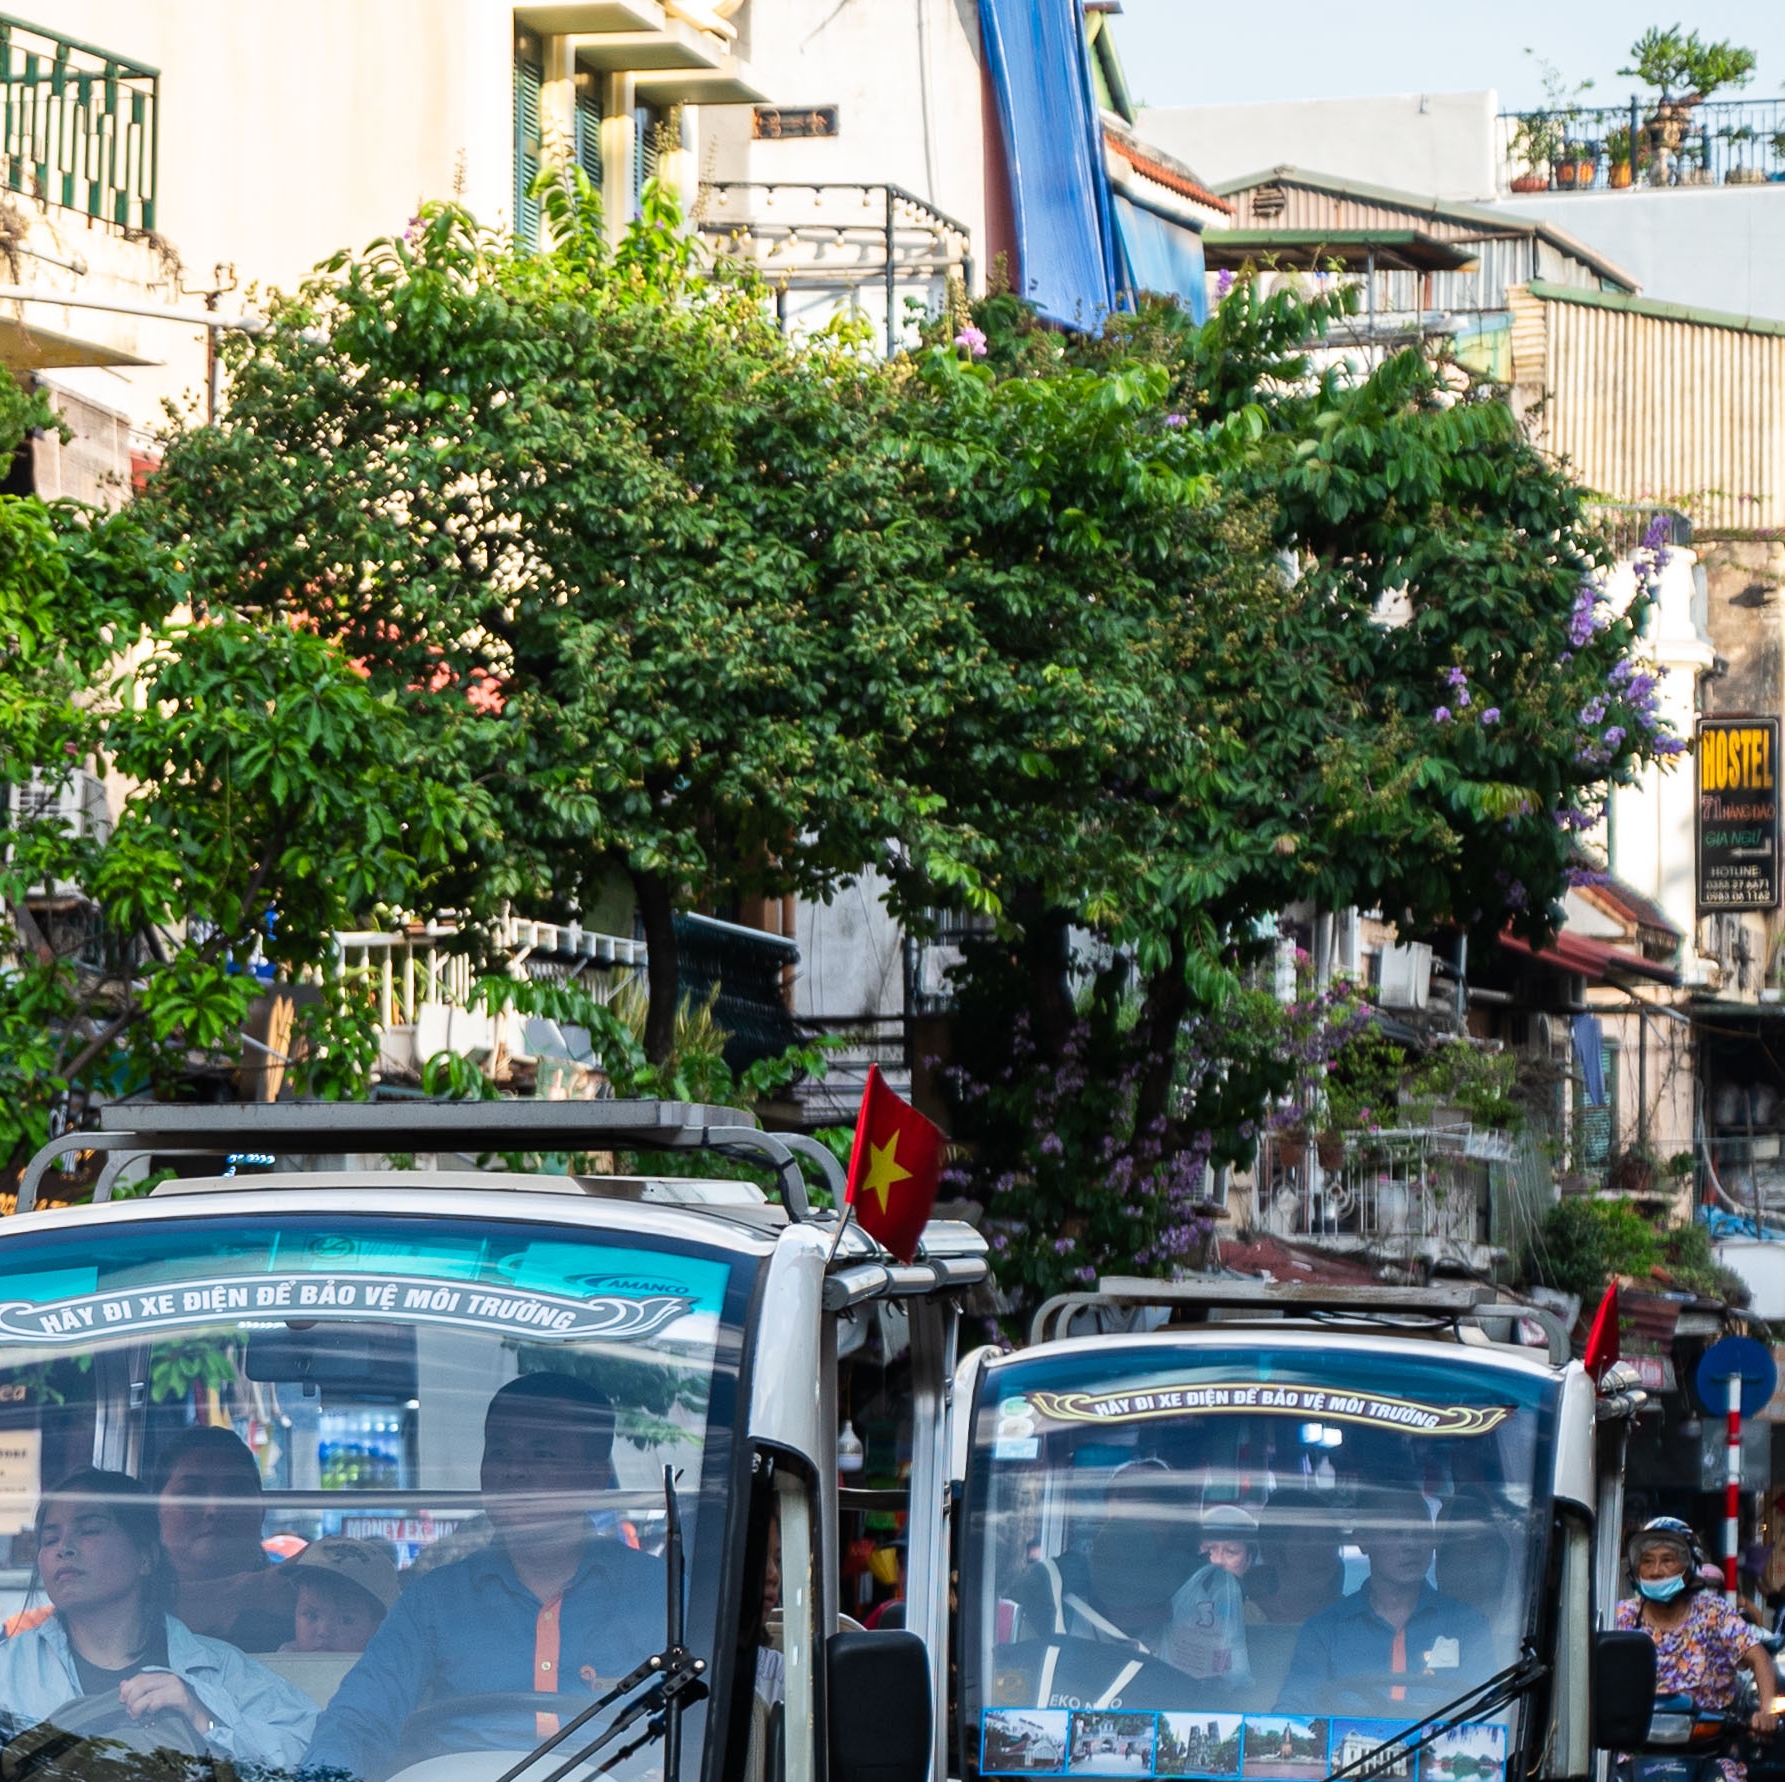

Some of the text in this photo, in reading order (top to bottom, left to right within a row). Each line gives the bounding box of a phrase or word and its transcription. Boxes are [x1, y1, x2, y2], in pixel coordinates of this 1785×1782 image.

[1702, 728, 1773, 790] HOSTEL
[39, 1279, 577, 1335] HÃY ĐI XE ĐIỆN ĐỂ BẢO VỆ MÔI TRƯỜNG
[607, 1279, 690, 1294] AMANCO
[1094, 1386, 1441, 1429] HÃY ĐI XE ĐIỆN ĐỂ BẢO VỆ MÔI TRƯỜNG
[346, 1519, 400, 1541] MONEY
